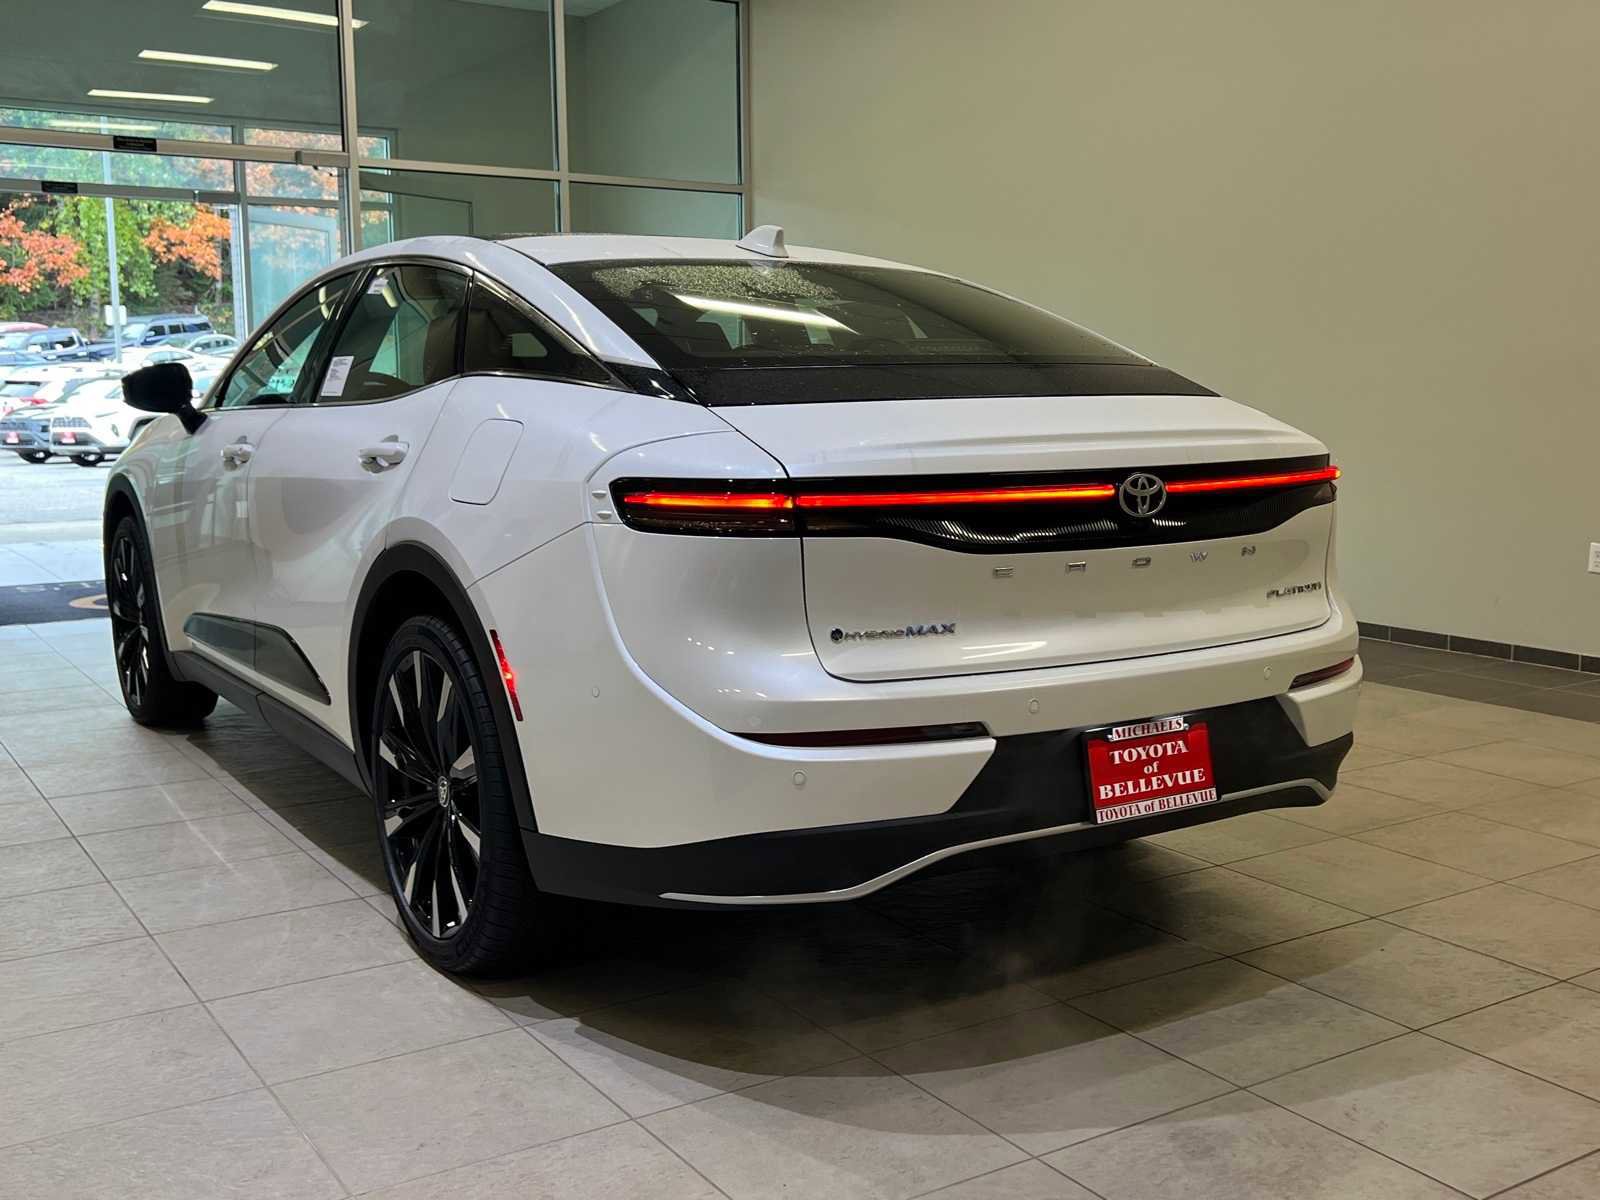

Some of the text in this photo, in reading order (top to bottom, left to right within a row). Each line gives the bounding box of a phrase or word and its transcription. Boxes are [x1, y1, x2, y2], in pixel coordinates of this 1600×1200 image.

[1114, 719, 1183, 739] MICHAELS
[1109, 740, 1189, 764] TOYOTA
[1143, 761, 1159, 774] of
[1098, 768, 1206, 800] BELLEVUE
[1098, 789, 1217, 823] TOYOTA of BELLEVUE
